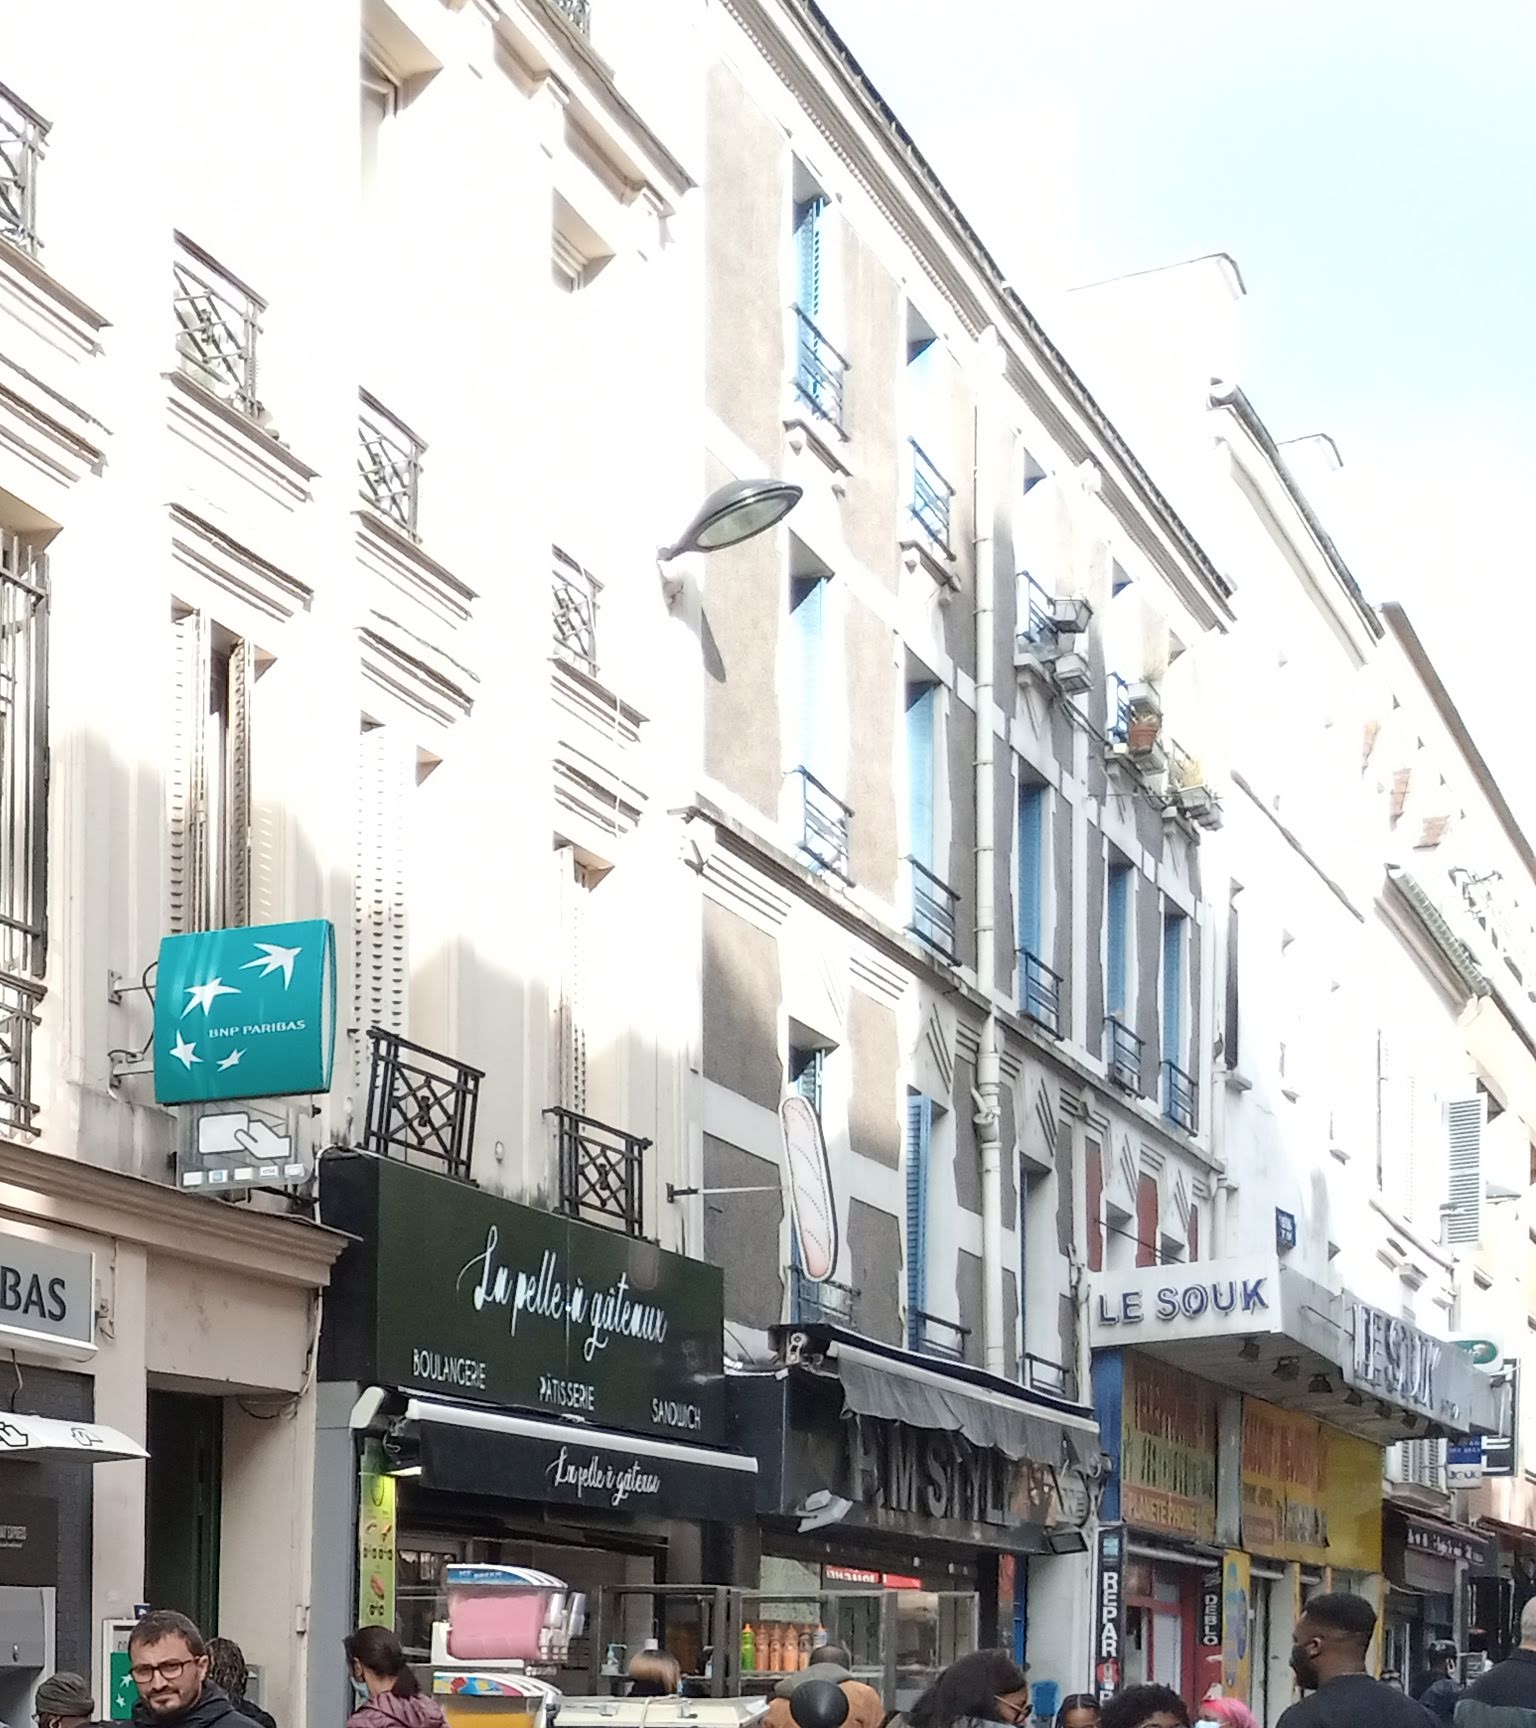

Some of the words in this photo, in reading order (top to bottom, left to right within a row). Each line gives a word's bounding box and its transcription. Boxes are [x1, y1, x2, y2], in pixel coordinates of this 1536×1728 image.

[209, 1026, 239, 1038] BNP
[243, 1020, 306, 1035] PARIBAS
[457, 1225, 512, 1310] La
[1099, 1291, 1144, 1325] LE
[1156, 1277, 1269, 1320] SOUK
[413, 1349, 486, 1389] BOULANGERIE
[652, 1398, 701, 1430] SANDWICH
